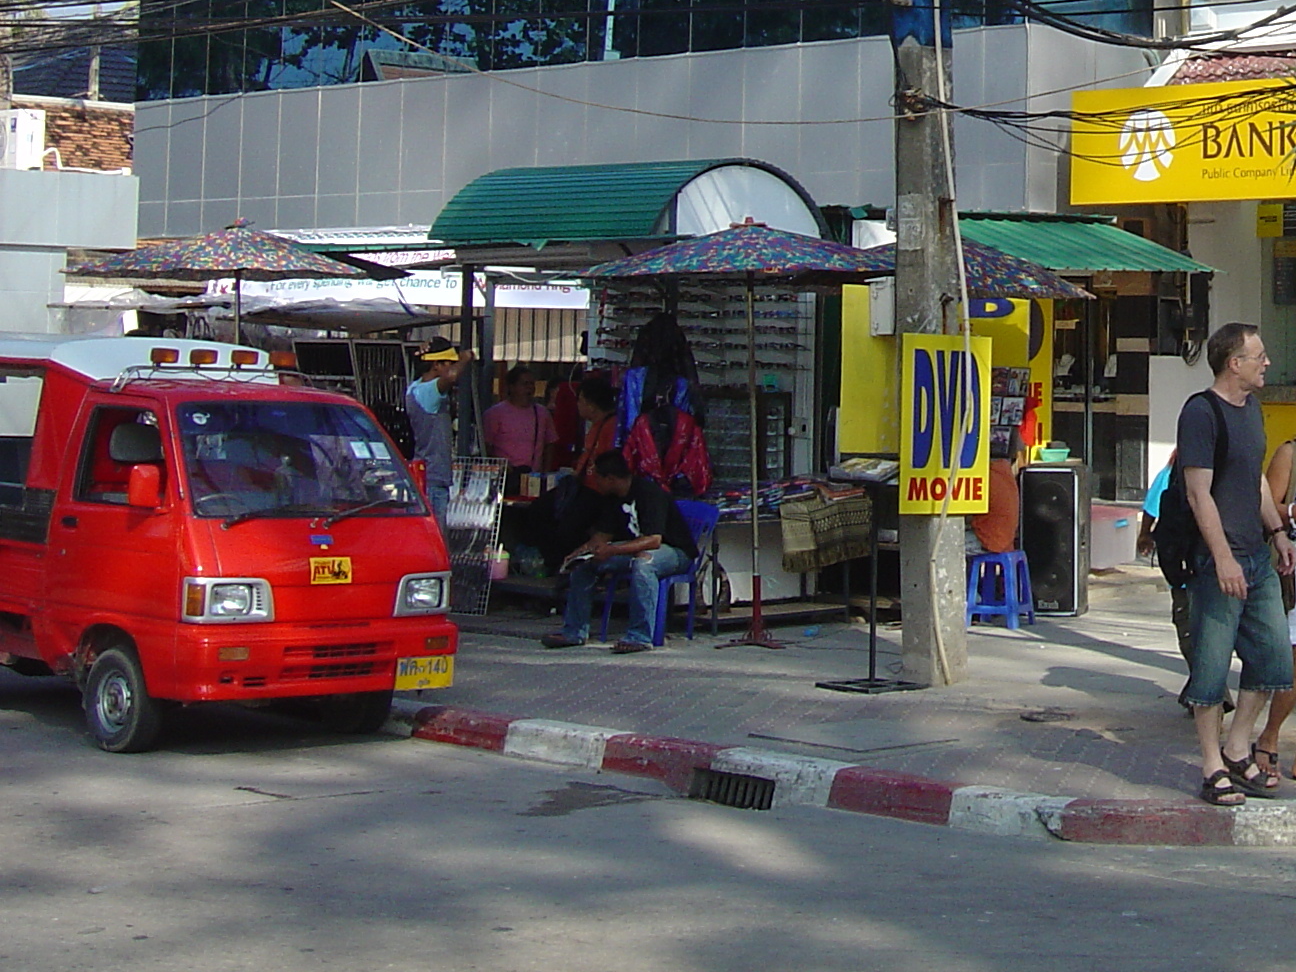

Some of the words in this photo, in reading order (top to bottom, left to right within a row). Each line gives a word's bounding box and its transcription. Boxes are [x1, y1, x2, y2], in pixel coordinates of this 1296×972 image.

[1202, 167, 1228, 180] Public
[1232, 166, 1275, 181] Company
[399, 277, 441, 289] chance
[445, 278, 458, 289] to
[912, 348, 982, 469] DVD
[907, 477, 983, 501] MOVIE
